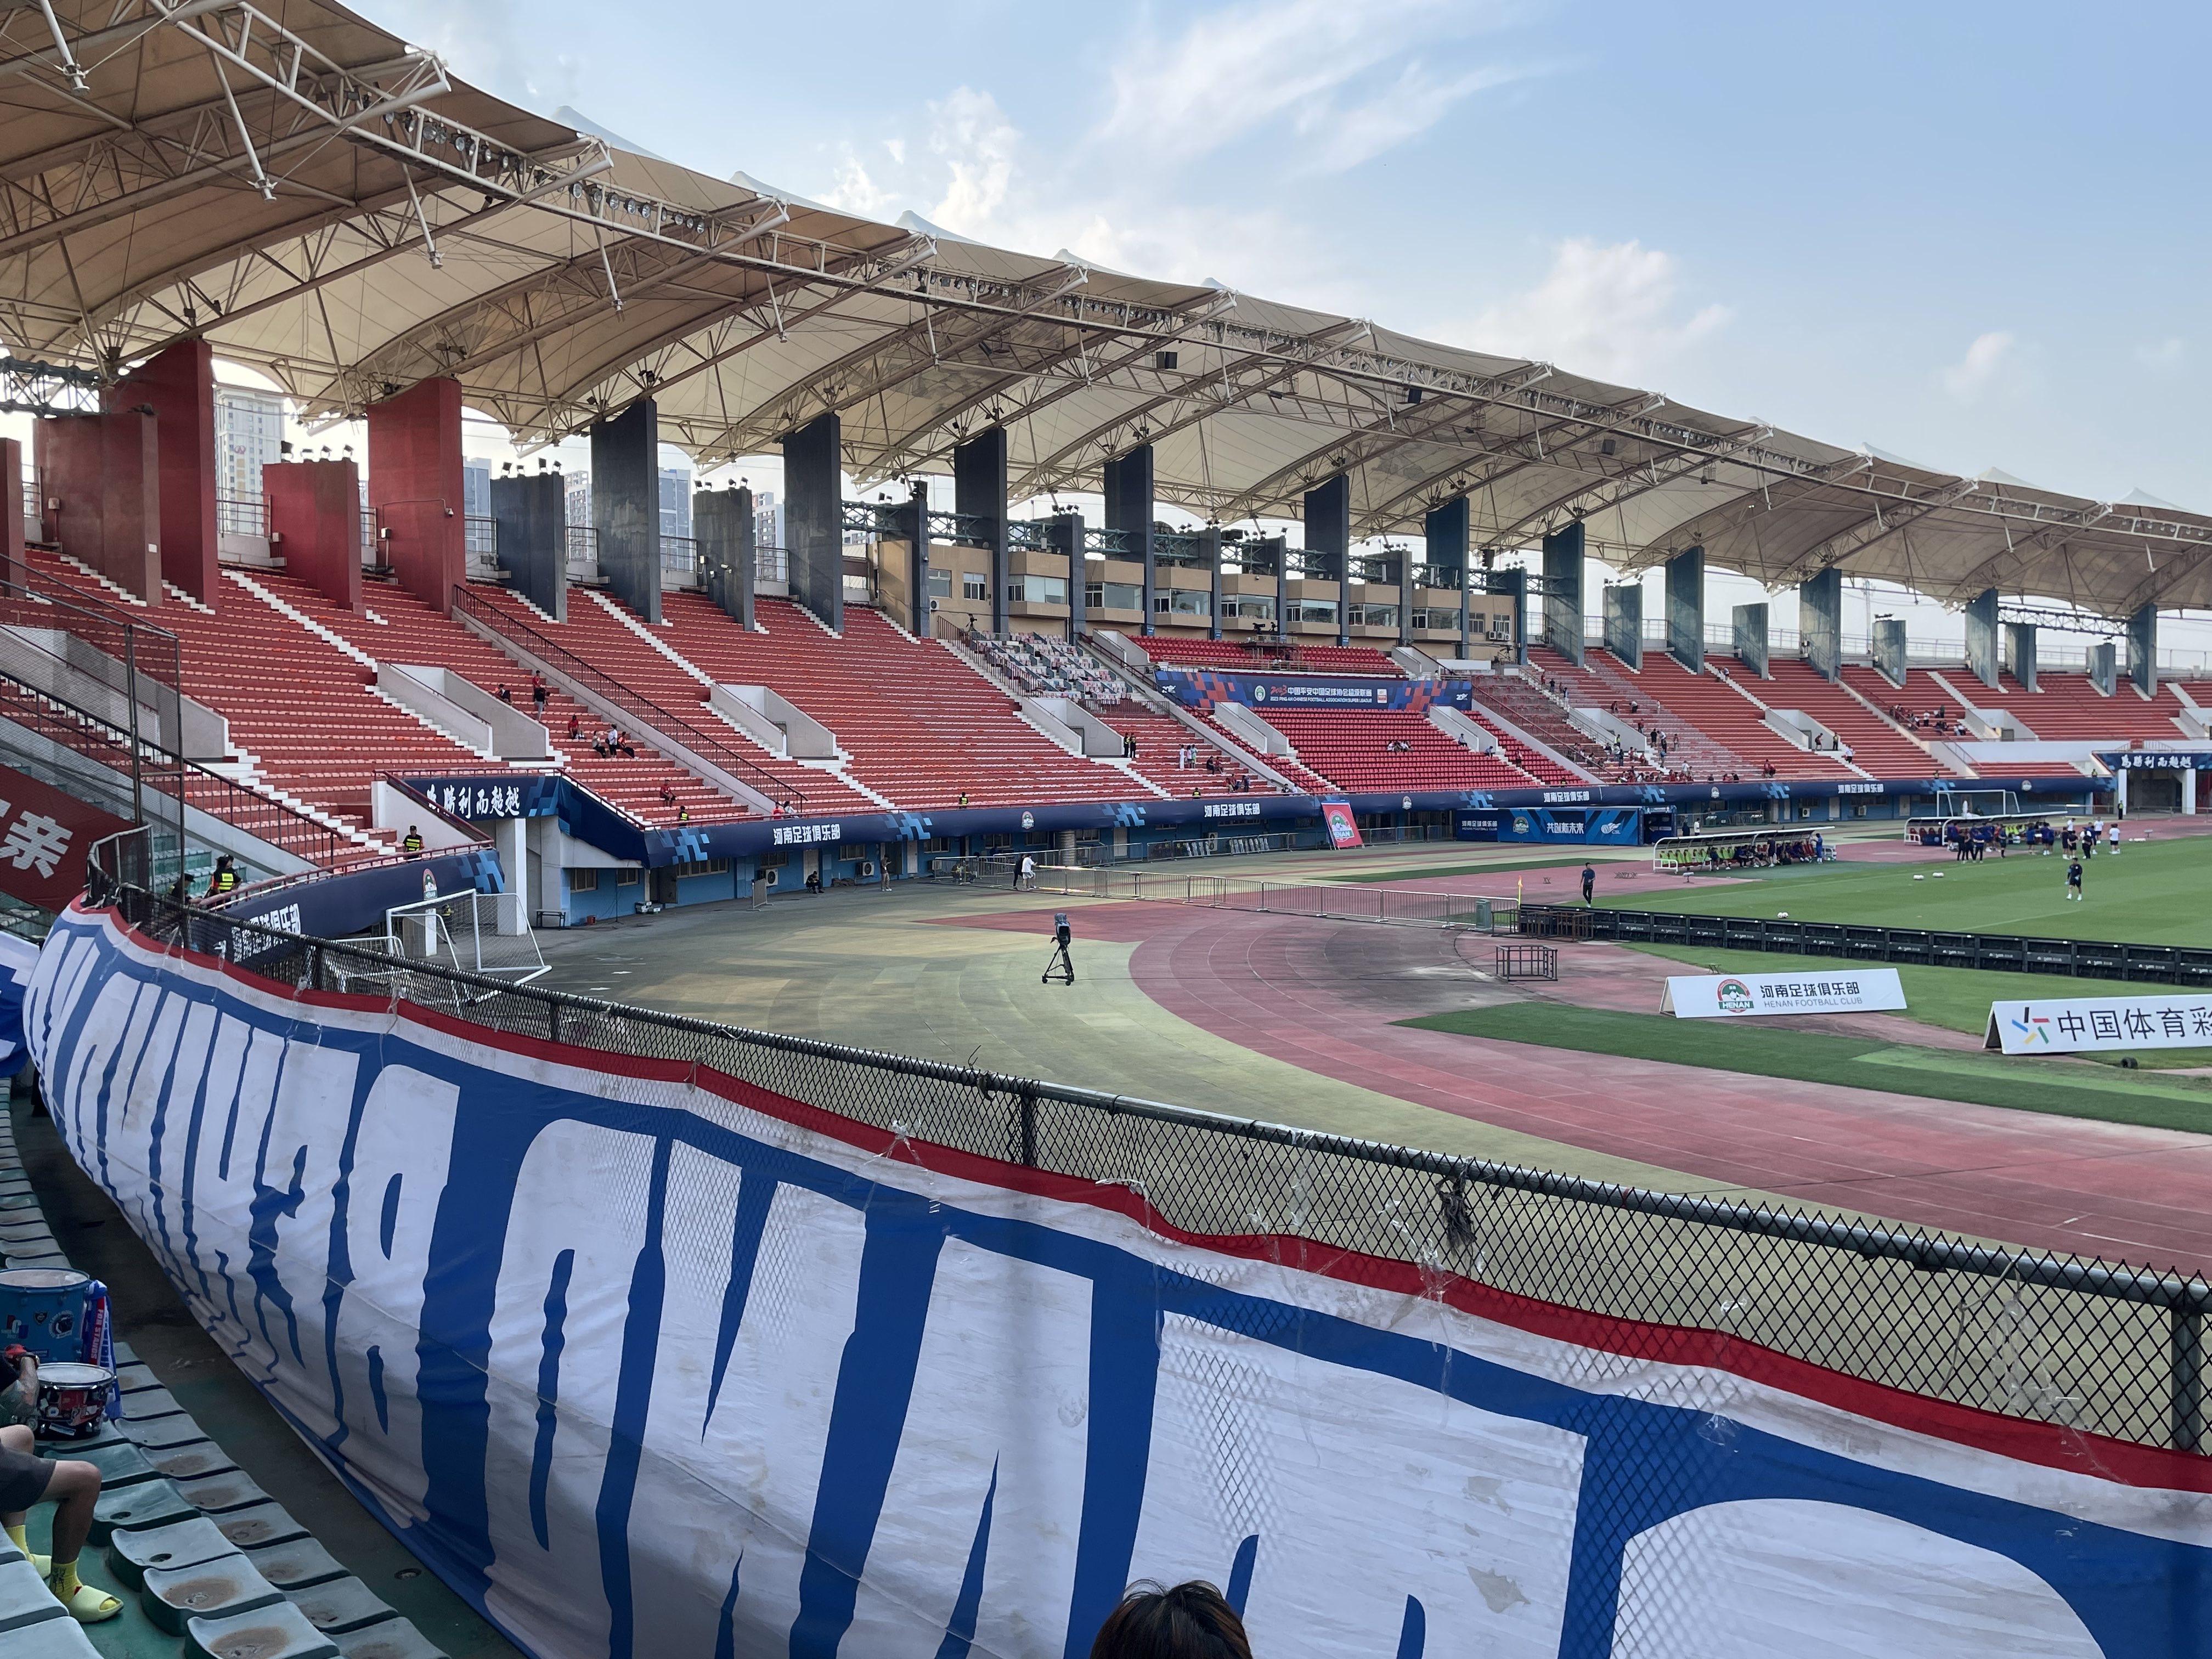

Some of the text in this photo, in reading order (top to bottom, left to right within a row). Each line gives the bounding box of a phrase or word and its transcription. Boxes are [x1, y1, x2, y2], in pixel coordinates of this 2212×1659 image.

[1288, 687, 1372, 697] 中国平安中国足球协会超级联赛
[1543, 791, 1589, 803] 河南足球俱乐部
[1204, 803, 1260, 817] 河南足球俱乐部
[773, 823, 840, 845] 河南足球俱乐部
[1547, 822, 1584, 834] 共创新未来
[1760, 982, 1860, 998] 河南足球俱乐部
[1796, 998, 1838, 1007] FOOTBALL
[2057, 1007, 2212, 1042] 中国体育彩
